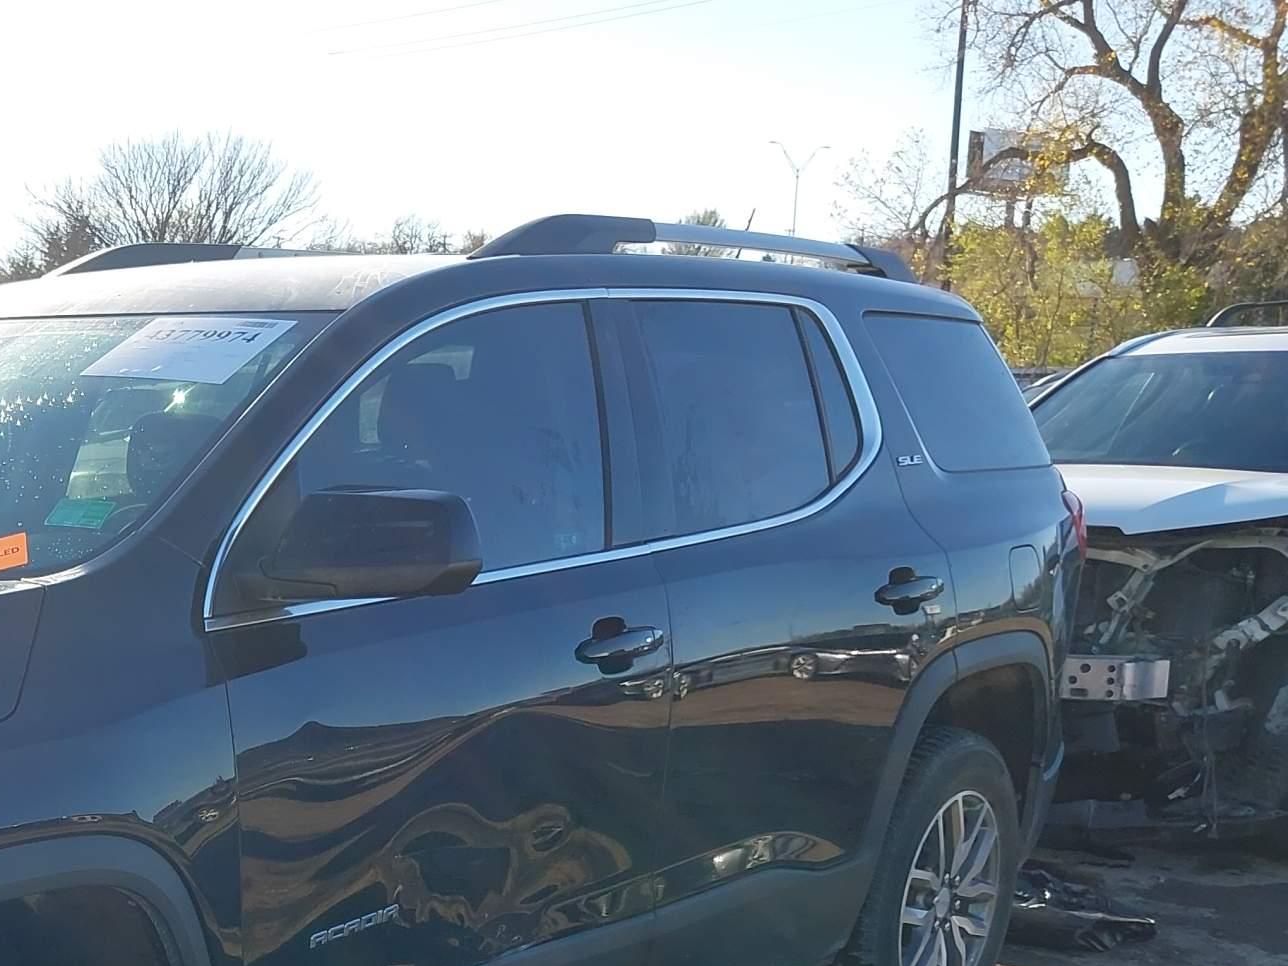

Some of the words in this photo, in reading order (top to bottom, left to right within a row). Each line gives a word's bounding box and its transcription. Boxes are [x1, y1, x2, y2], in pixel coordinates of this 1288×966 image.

[144, 329, 262, 343] 43779974
[897, 454, 923, 467] SLE
[310, 903, 399, 949] ACADIA
